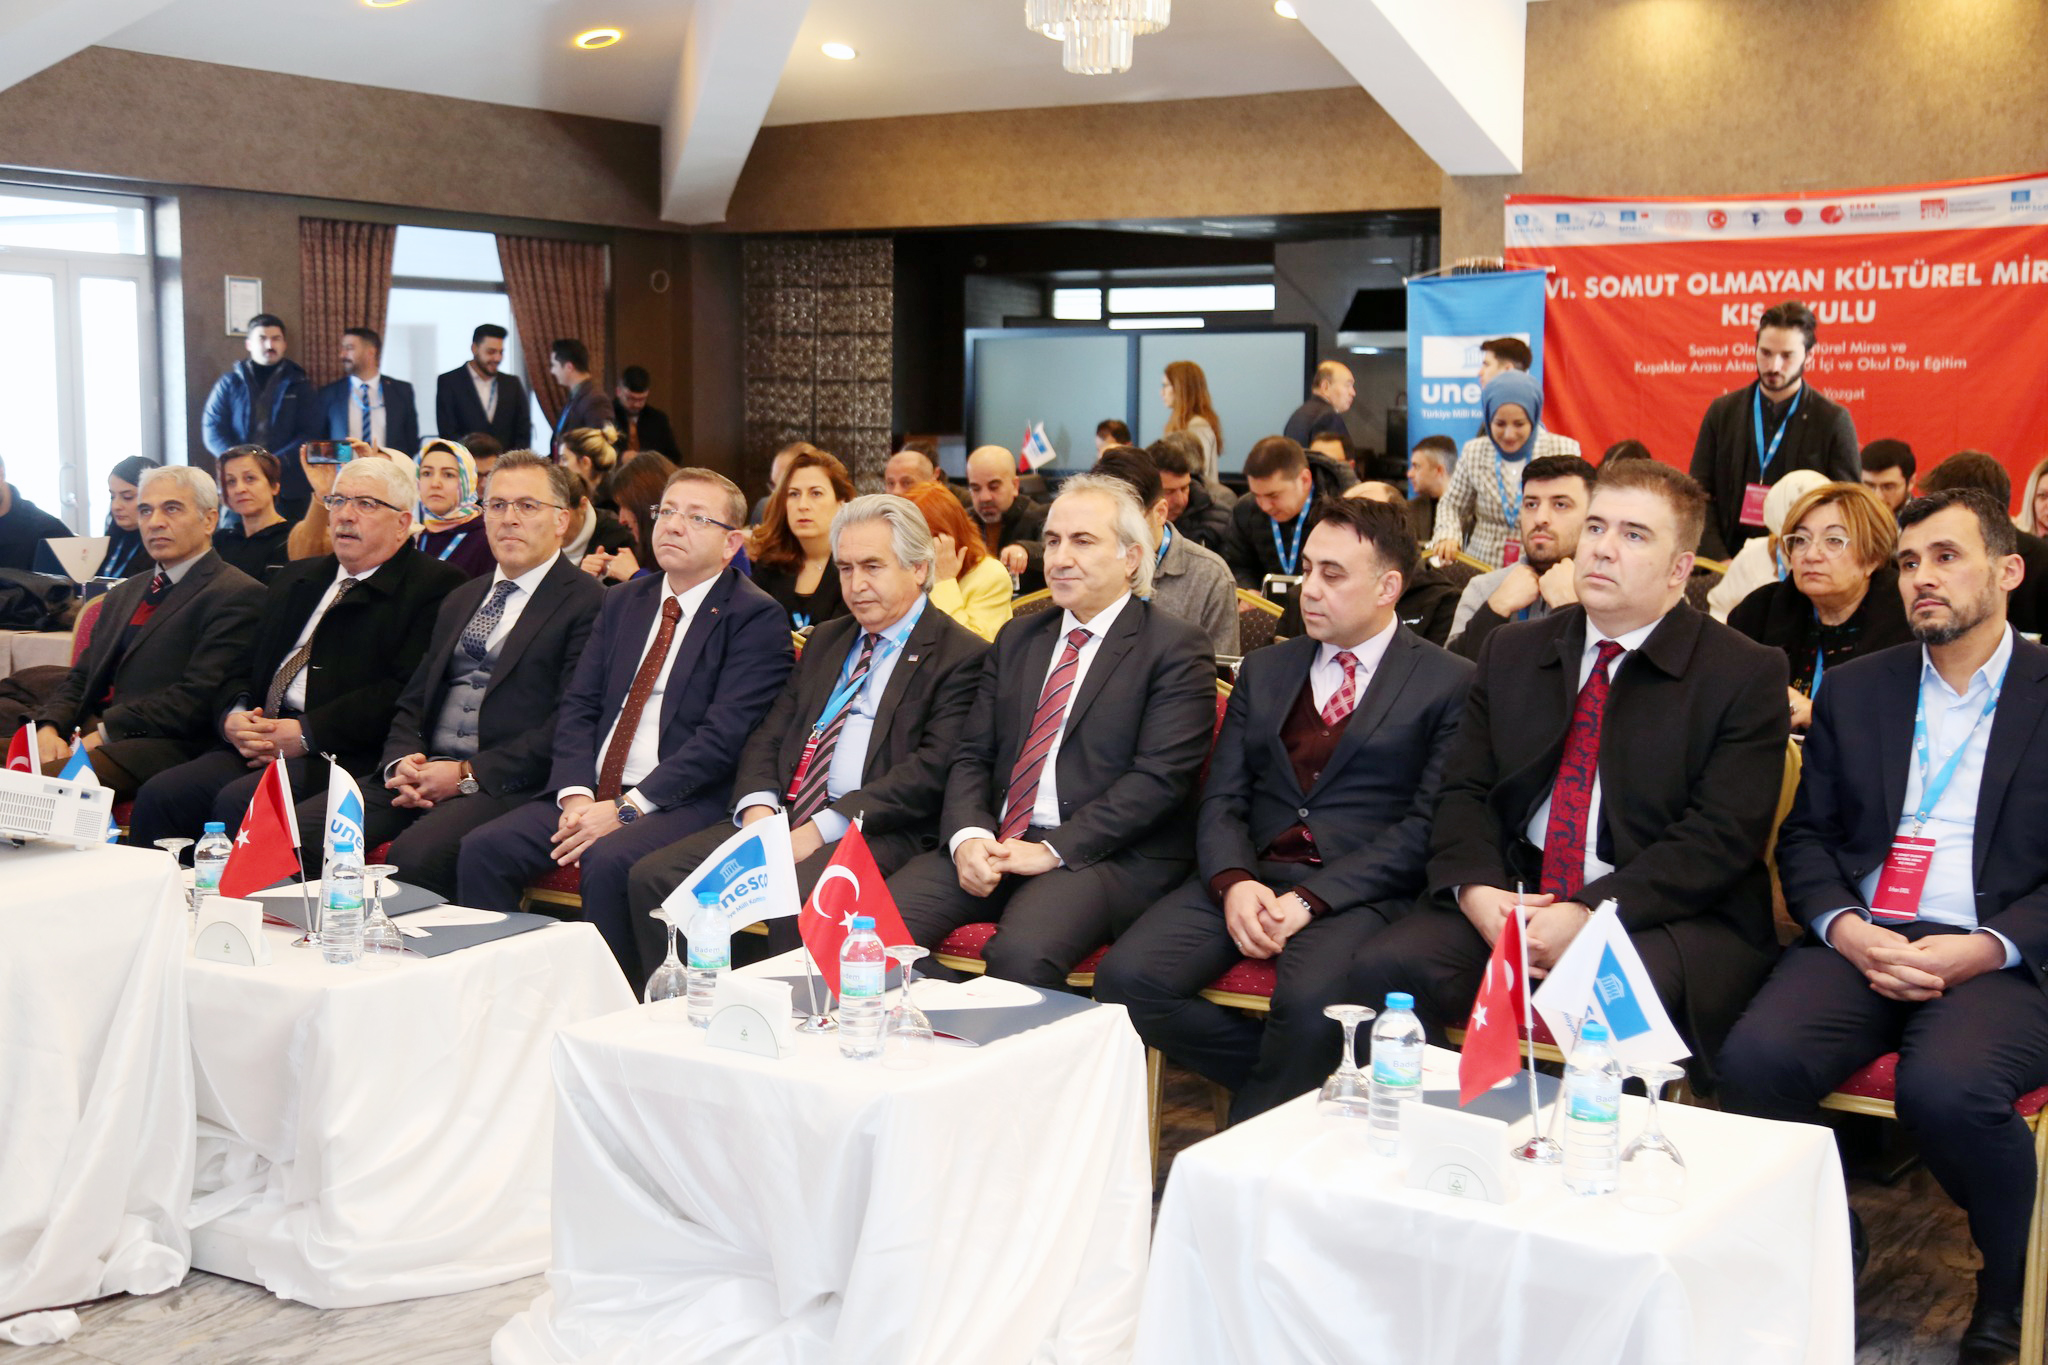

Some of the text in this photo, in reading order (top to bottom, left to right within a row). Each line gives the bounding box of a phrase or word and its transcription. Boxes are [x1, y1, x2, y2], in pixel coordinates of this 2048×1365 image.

[1584, 273, 1680, 299] SOMUT
[1686, 267, 1825, 297] OLMAYAN
[1834, 258, 1982, 292] KÜLTÜREL
[1721, 302, 1765, 332] KIŞ
[1689, 343, 1729, 358] Somut
[1850, 340, 1887, 354] Miras
[1890, 342, 1907, 354] ve
[1634, 360, 1687, 376] Kuşaklar
[1690, 359, 1722, 373] Arası
[1838, 360, 1853, 371] ve
[1857, 357, 1890, 371] Okul
[1894, 356, 1920, 372] Dışı
[1924, 355, 1967, 373] Eğitim
[1421, 383, 1482, 405] une
[1823, 387, 1865, 403] Yozgat
[1422, 408, 1452, 421] Türkiye
[1452, 408, 1470, 418] Milli
[330, 819, 363, 850] une
[720, 872, 768, 909] nesco
